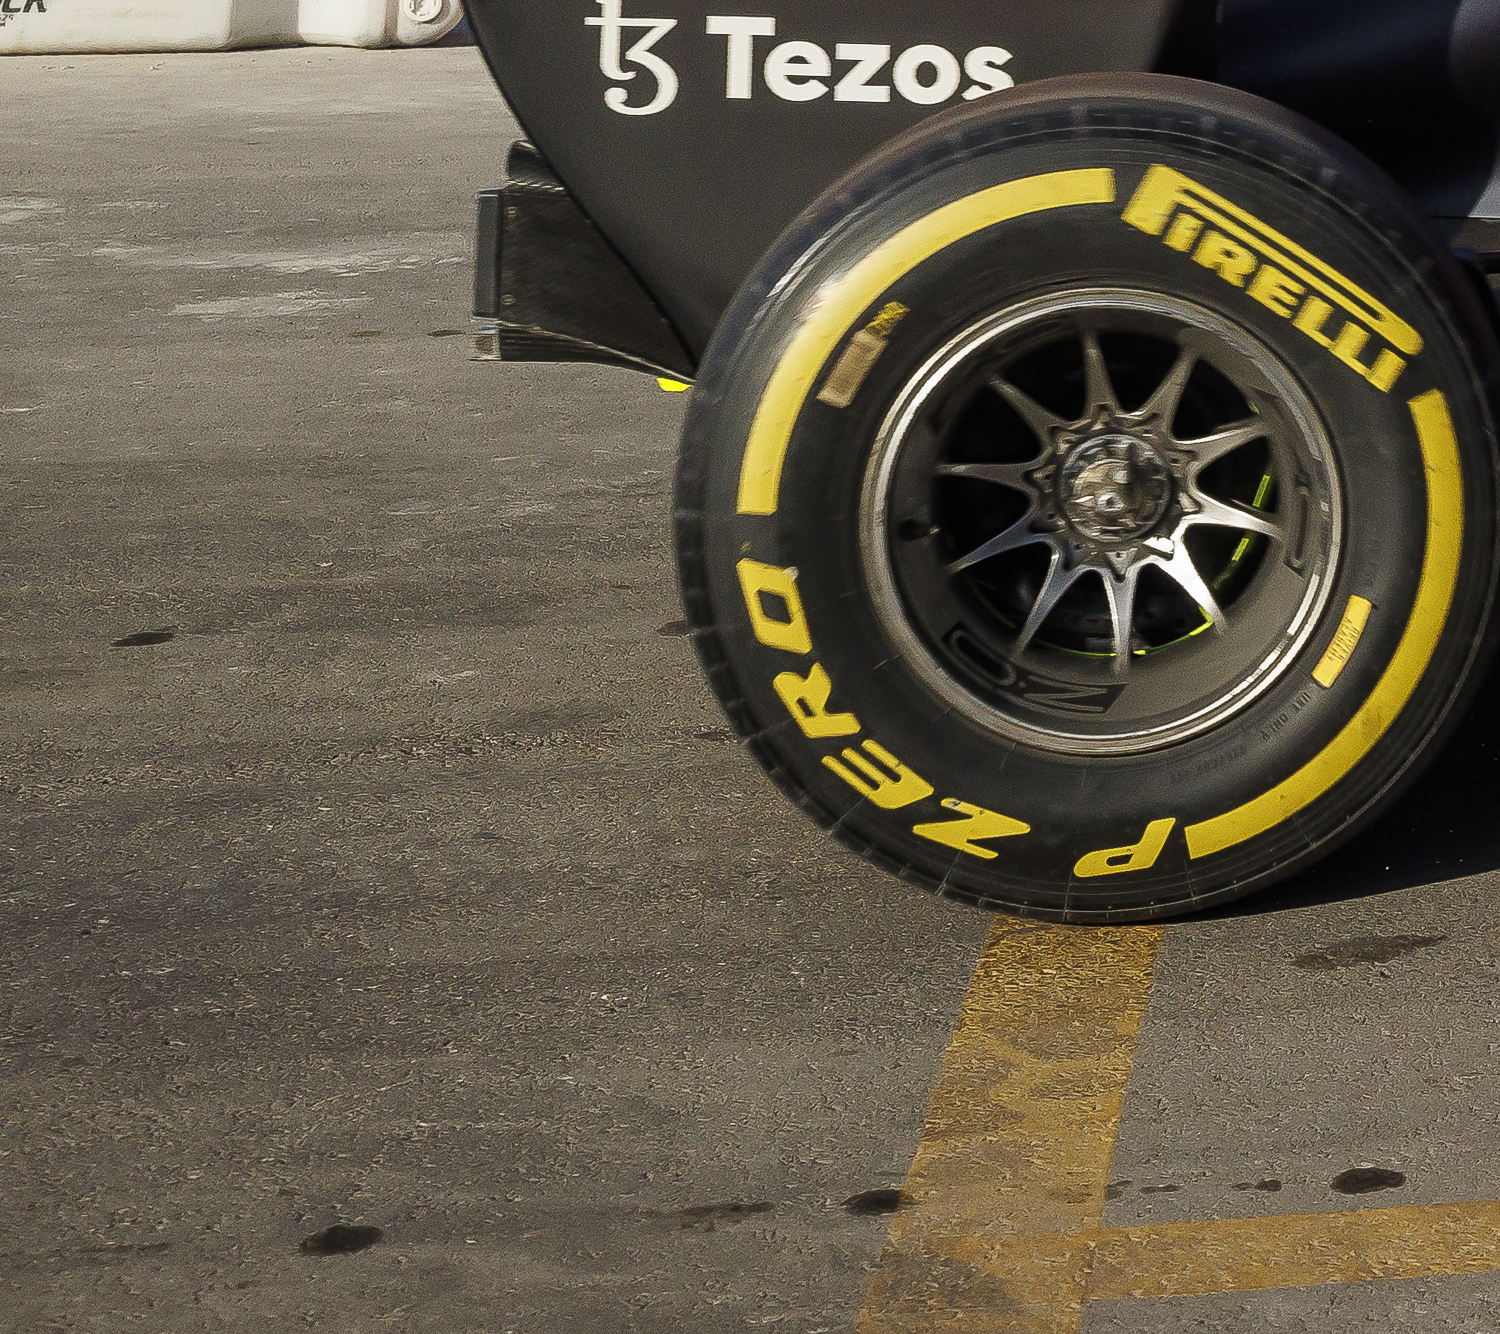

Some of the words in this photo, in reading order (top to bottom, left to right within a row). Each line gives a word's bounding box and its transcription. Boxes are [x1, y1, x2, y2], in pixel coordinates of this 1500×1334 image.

[706, 14, 1015, 104] Tezos
[1121, 163, 1424, 393] PIRELLI
[735, 556, 1031, 860] ZERO
[1073, 817, 1176, 879] P
